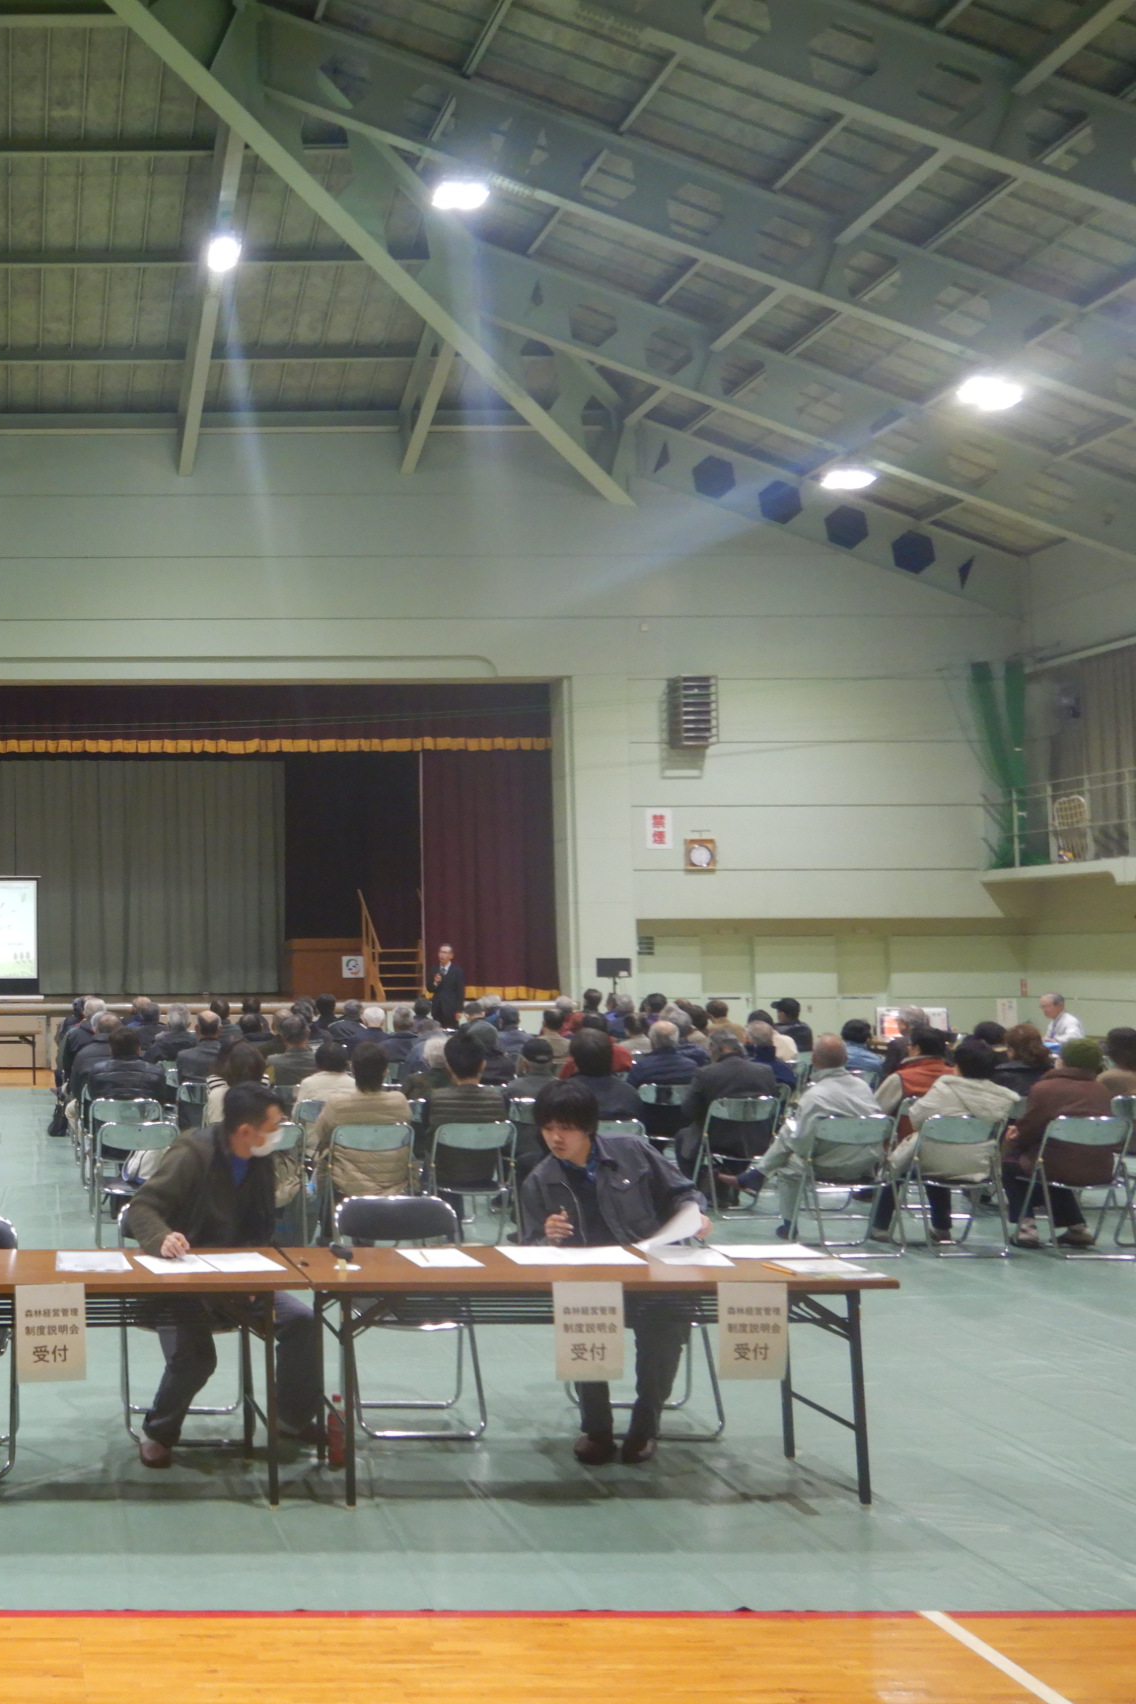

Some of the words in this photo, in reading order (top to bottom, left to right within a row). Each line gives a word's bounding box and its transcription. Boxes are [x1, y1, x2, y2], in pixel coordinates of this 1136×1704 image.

[25, 1308, 79, 1317] 森林経営管理
[563, 1306, 617, 1315] 森林経営管理
[727, 1306, 781, 1316] 森林経営管理
[24, 1324, 80, 1336] 制度説明会
[563, 1322, 618, 1334] 制度説明会
[727, 1323, 782, 1334] 制度説明会
[32, 1344, 70, 1364] 受付
[570, 1342, 607, 1362] 受付
[734, 1342, 770, 1361] 受付
